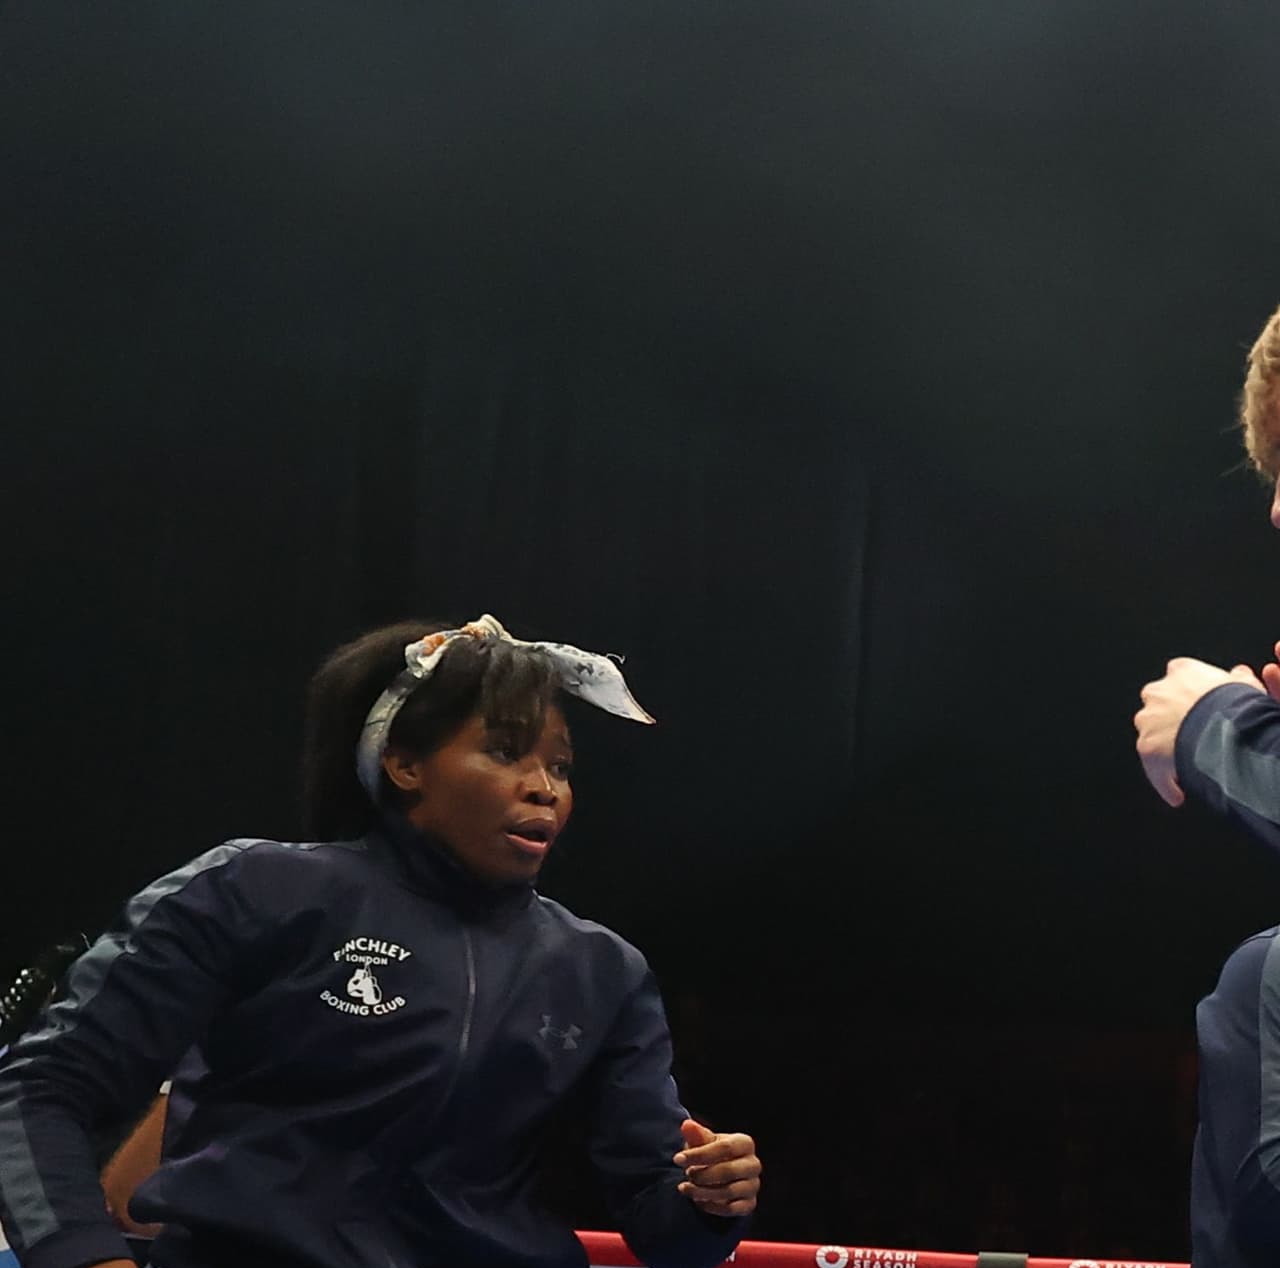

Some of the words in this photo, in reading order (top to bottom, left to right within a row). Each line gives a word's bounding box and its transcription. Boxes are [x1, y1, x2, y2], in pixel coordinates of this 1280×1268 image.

[333, 937, 411, 961] FINCHLEY
[346, 954, 388, 965] LONDON
[320, 990, 370, 1016] BOXING
[373, 996, 406, 1015] CLUB
[854, 1250, 918, 1261] RIYADH
